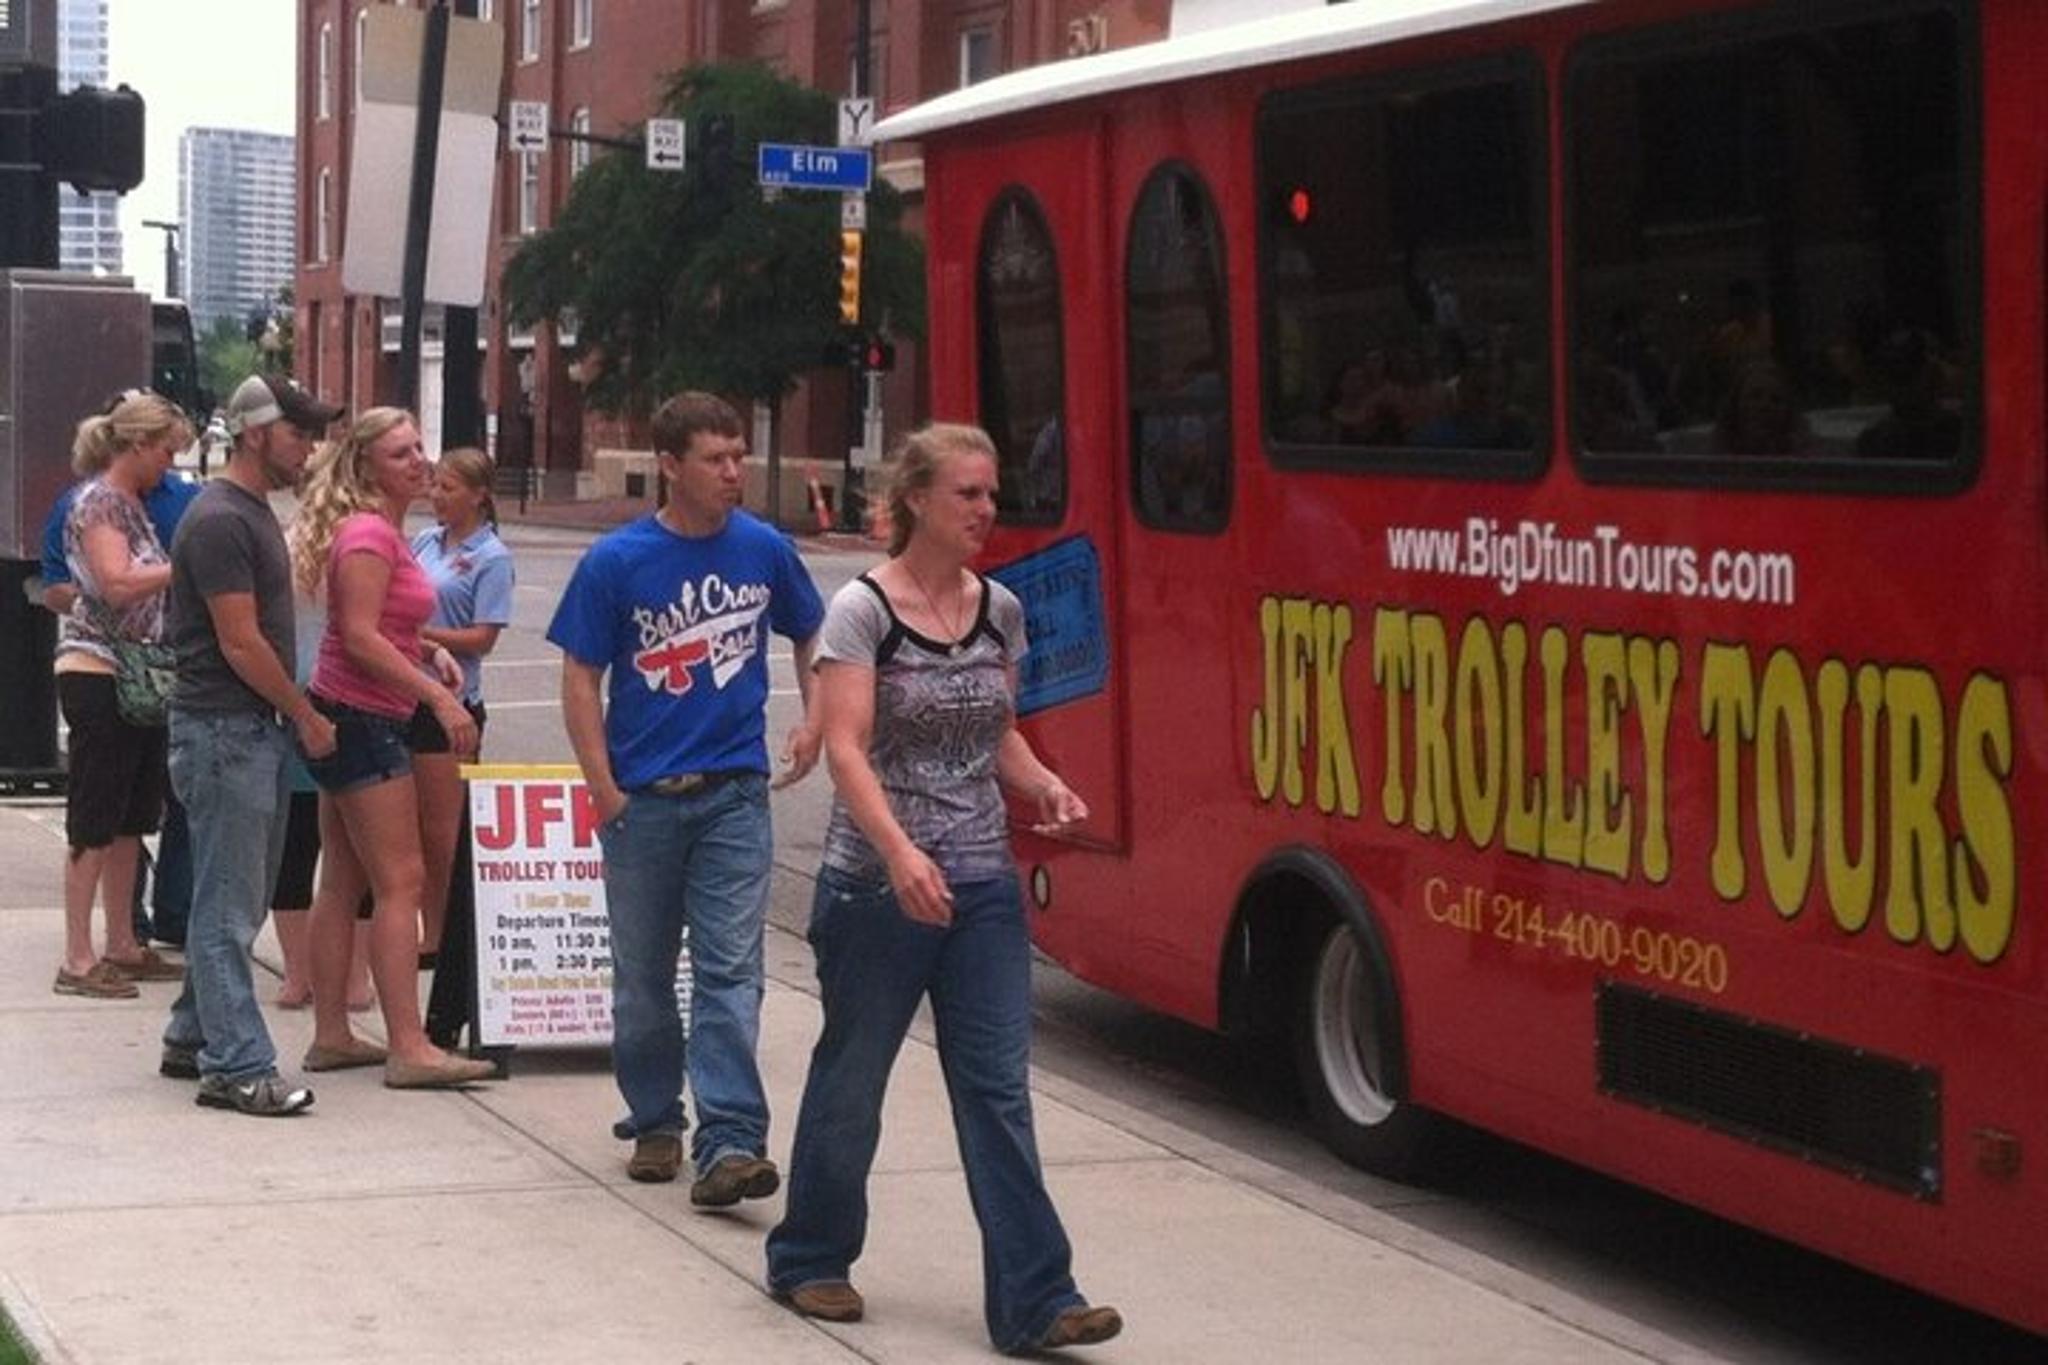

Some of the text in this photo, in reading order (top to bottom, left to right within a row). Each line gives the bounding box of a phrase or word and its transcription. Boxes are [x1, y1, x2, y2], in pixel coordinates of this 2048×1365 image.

[517, 119, 543, 129] WAY
[792, 152, 838, 173] Elm
[1387, 517, 1796, 604] www.BigDfunTours.com
[1250, 596, 2016, 965] JFK TROLLEY TOURS
[478, 861, 608, 882] TROLLEY TOU
[496, 913, 565, 931] Departure
[489, 935, 507, 950] 10
[555, 933, 595, 949] 11:30
[1424, 878, 1728, 993] Call 214-400-9020
[499, 956, 507, 970] 1
[556, 954, 588, 969] 2:30
